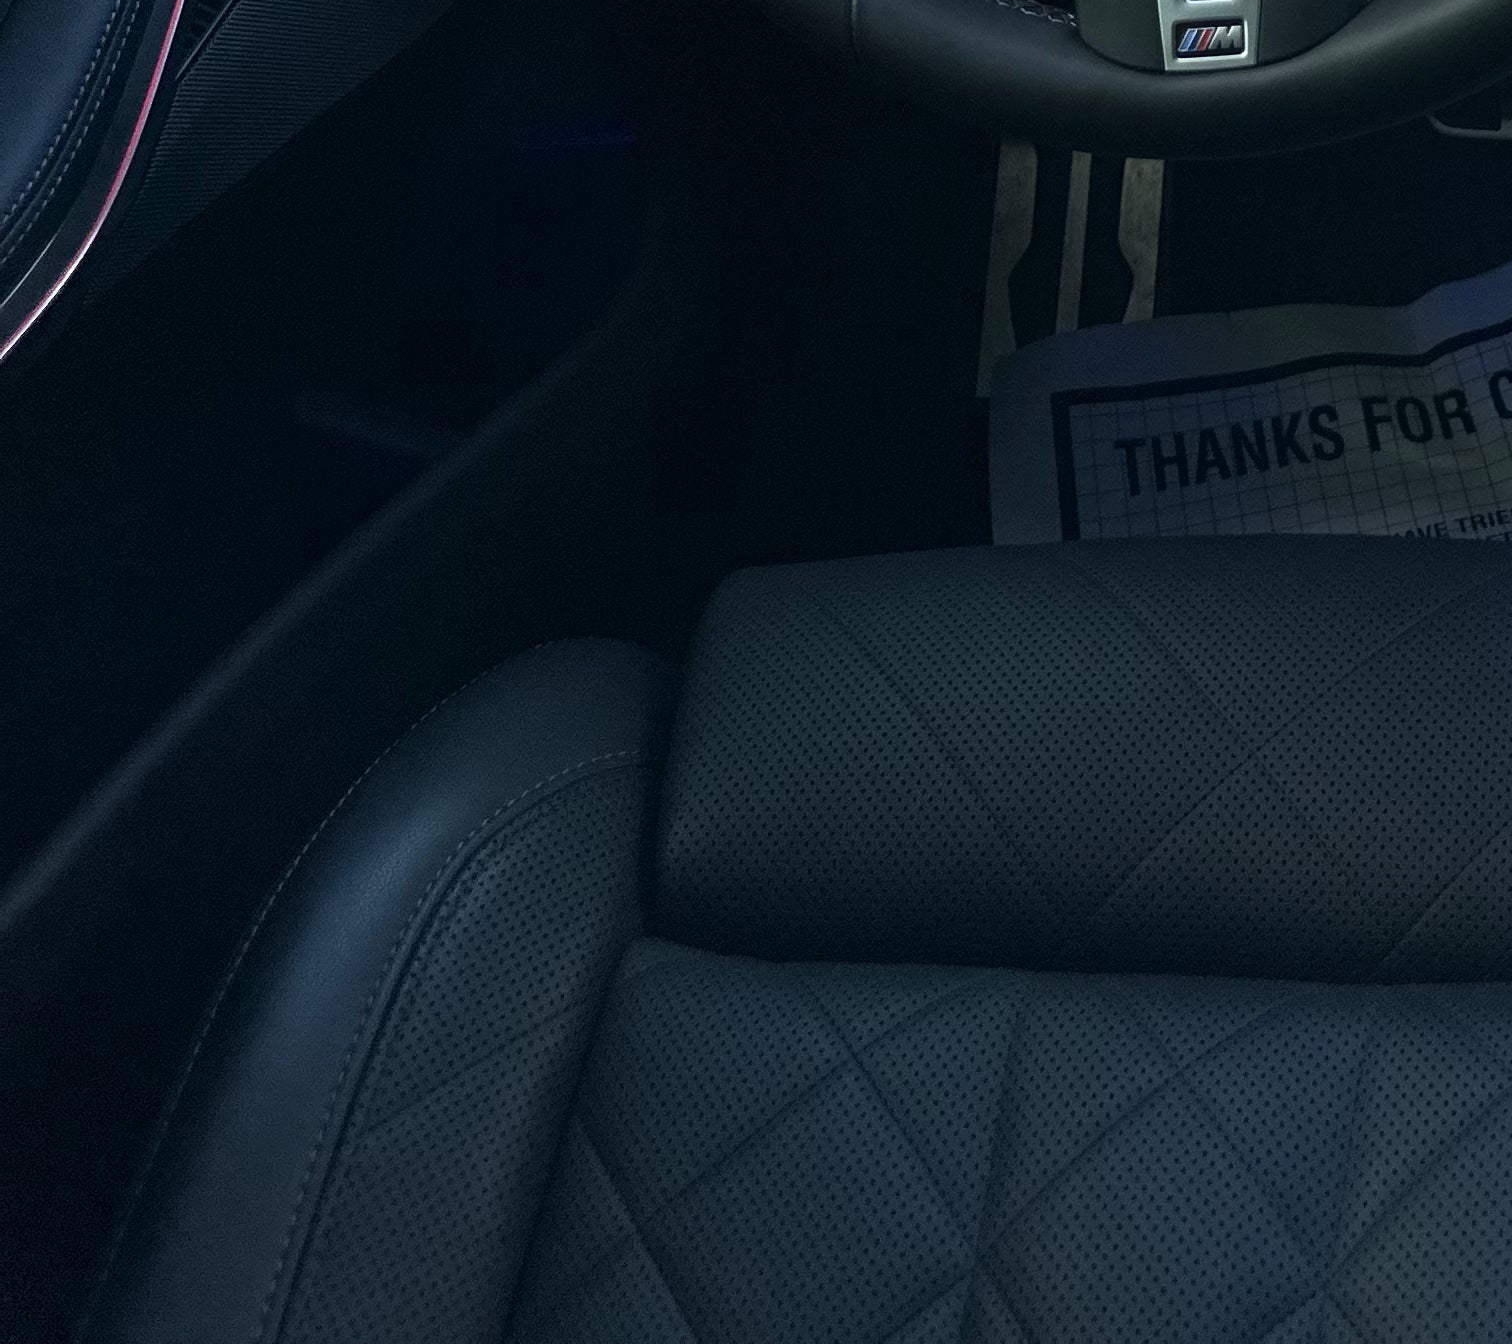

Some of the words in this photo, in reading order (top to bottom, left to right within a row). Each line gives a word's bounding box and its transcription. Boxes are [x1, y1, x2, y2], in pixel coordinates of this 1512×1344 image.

[1113, 403, 1346, 497] THANKS
[1360, 388, 1477, 454] FOR
[1394, 521, 1450, 541] AVE
